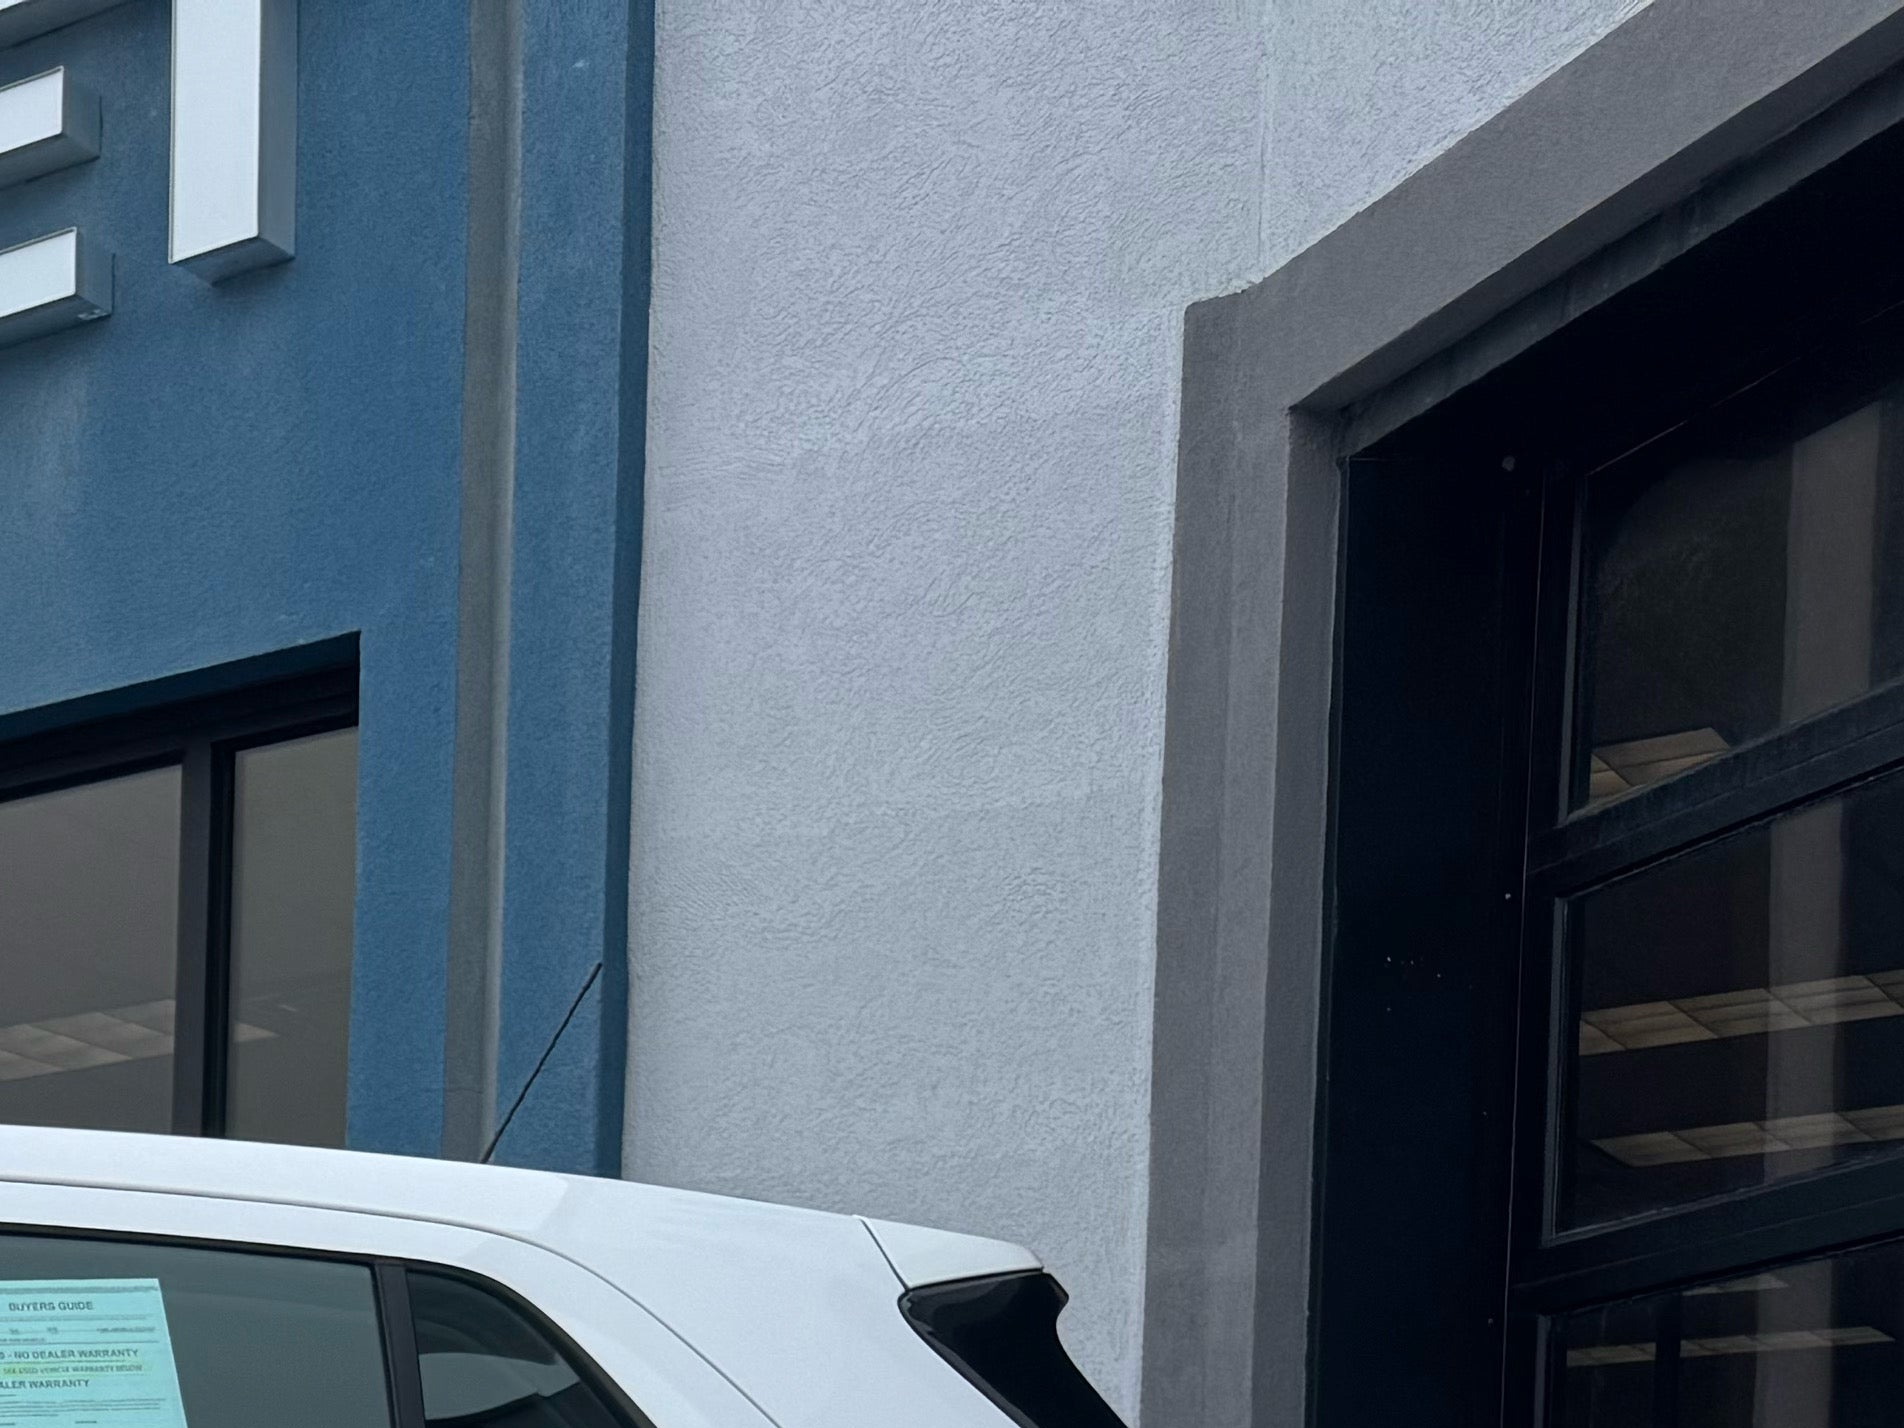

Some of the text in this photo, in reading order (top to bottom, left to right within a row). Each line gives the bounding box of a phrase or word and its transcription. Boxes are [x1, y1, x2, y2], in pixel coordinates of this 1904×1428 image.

[8, 1301, 93, 1312] BUYERS GUIDE
[14, 1351, 30, 1360] NO
[32, 1350, 75, 1360] DEALER
[78, 1348, 139, 1359] WARRANTY
[29, 1379, 90, 1389] WARRANTY
